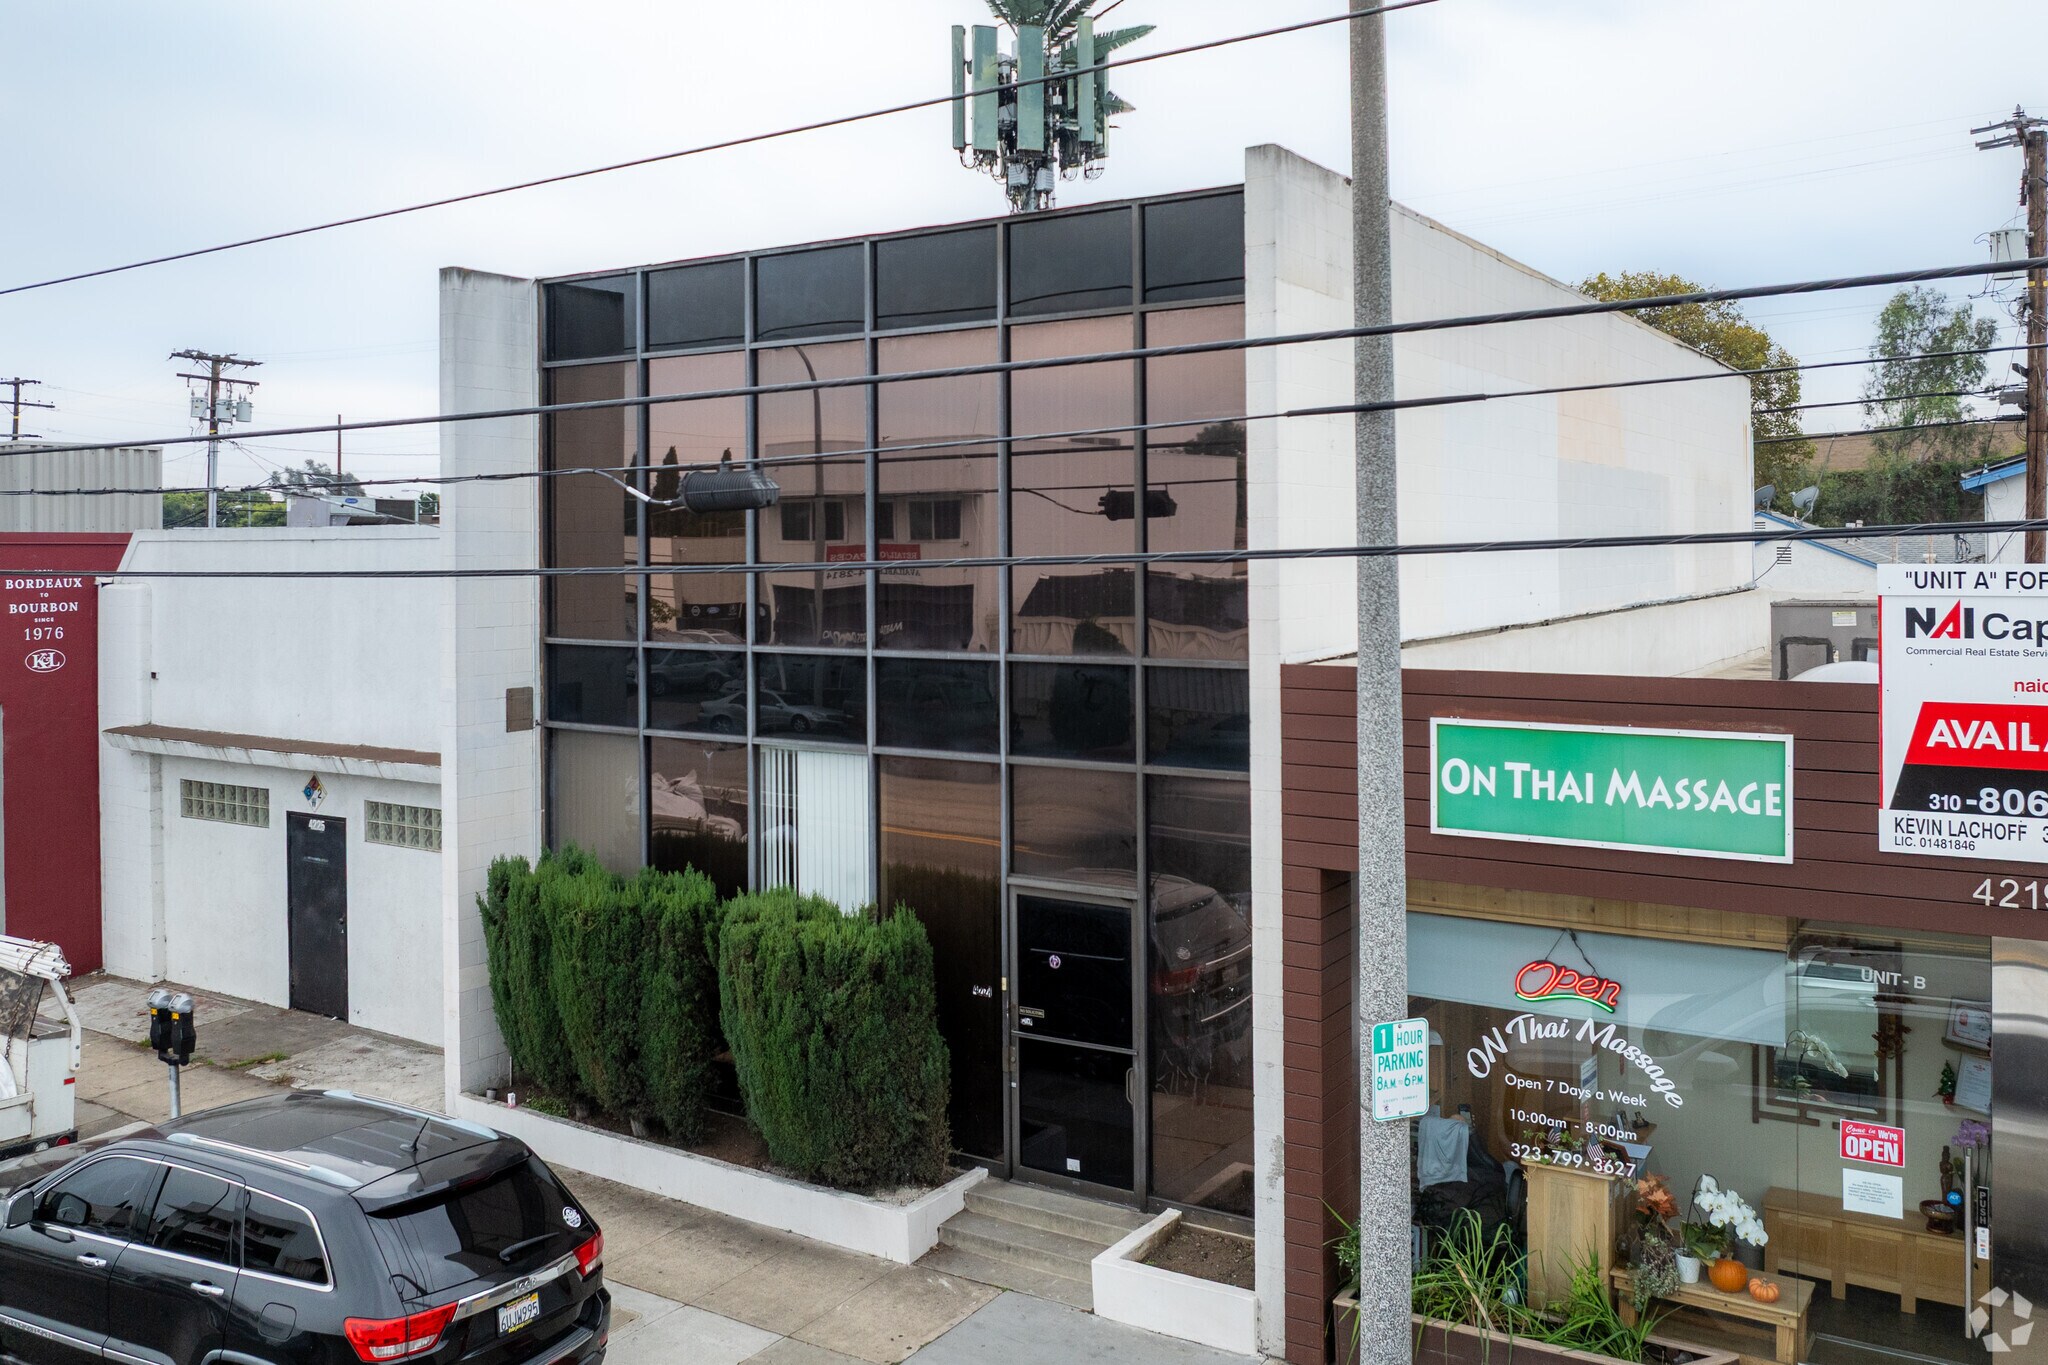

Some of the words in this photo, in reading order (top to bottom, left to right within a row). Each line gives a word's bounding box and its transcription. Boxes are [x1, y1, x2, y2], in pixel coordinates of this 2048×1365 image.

[5, 578, 82, 589] BORDEAUX
[1905, 571, 1967, 589] "UNIT
[1974, 571, 1997, 589] A"
[9, 602, 78, 613] BOURBON
[24, 627, 64, 641] 1976
[1905, 599, 1974, 639] NAI
[1982, 613, 2048, 647] Cap
[32, 652, 60, 669] K&L
[1905, 646, 1962, 656] Commercial
[1965, 648, 1987, 656] Real
[1989, 648, 2020, 657] Estate
[1926, 719, 2048, 753] AVAIL
[1441, 758, 1496, 797] ON
[1504, 761, 1594, 805] THAI
[1605, 767, 1782, 817] MASSAGE
[1894, 816, 1942, 836] KEVIN
[1948, 820, 2027, 842] LACHOFF
[1894, 836, 1916, 847] LIC.
[1920, 837, 1976, 851] 01481846
[1972, 878, 2048, 910] 421
[1514, 960, 1621, 1006] Open
[1380, 1028, 1387, 1049] 1
[1396, 1029, 1423, 1046] HOUR
[1377, 1050, 1424, 1073] PARKING
[1467, 1026, 1509, 1079] ON
[1505, 1013, 1571, 1044] Thai
[1575, 1016, 1684, 1109] Massage
[1504, 1073, 1542, 1092] Open
[1546, 1080, 1555, 1092] 7
[1559, 1082, 1592, 1100] Days
[1595, 1090, 1604, 1100] a
[1608, 1089, 1647, 1108] Week
[1509, 1108, 1567, 1130] 10:00am
[1585, 1121, 1637, 1142] 8:00pm
[1845, 1124, 1866, 1134] Come
[1877, 1129, 1898, 1141] We're
[1845, 1135, 1899, 1163] OPEN
[1979, 1191, 1987, 1225] PUSH
[513, 1277, 537, 1294] Jeep
